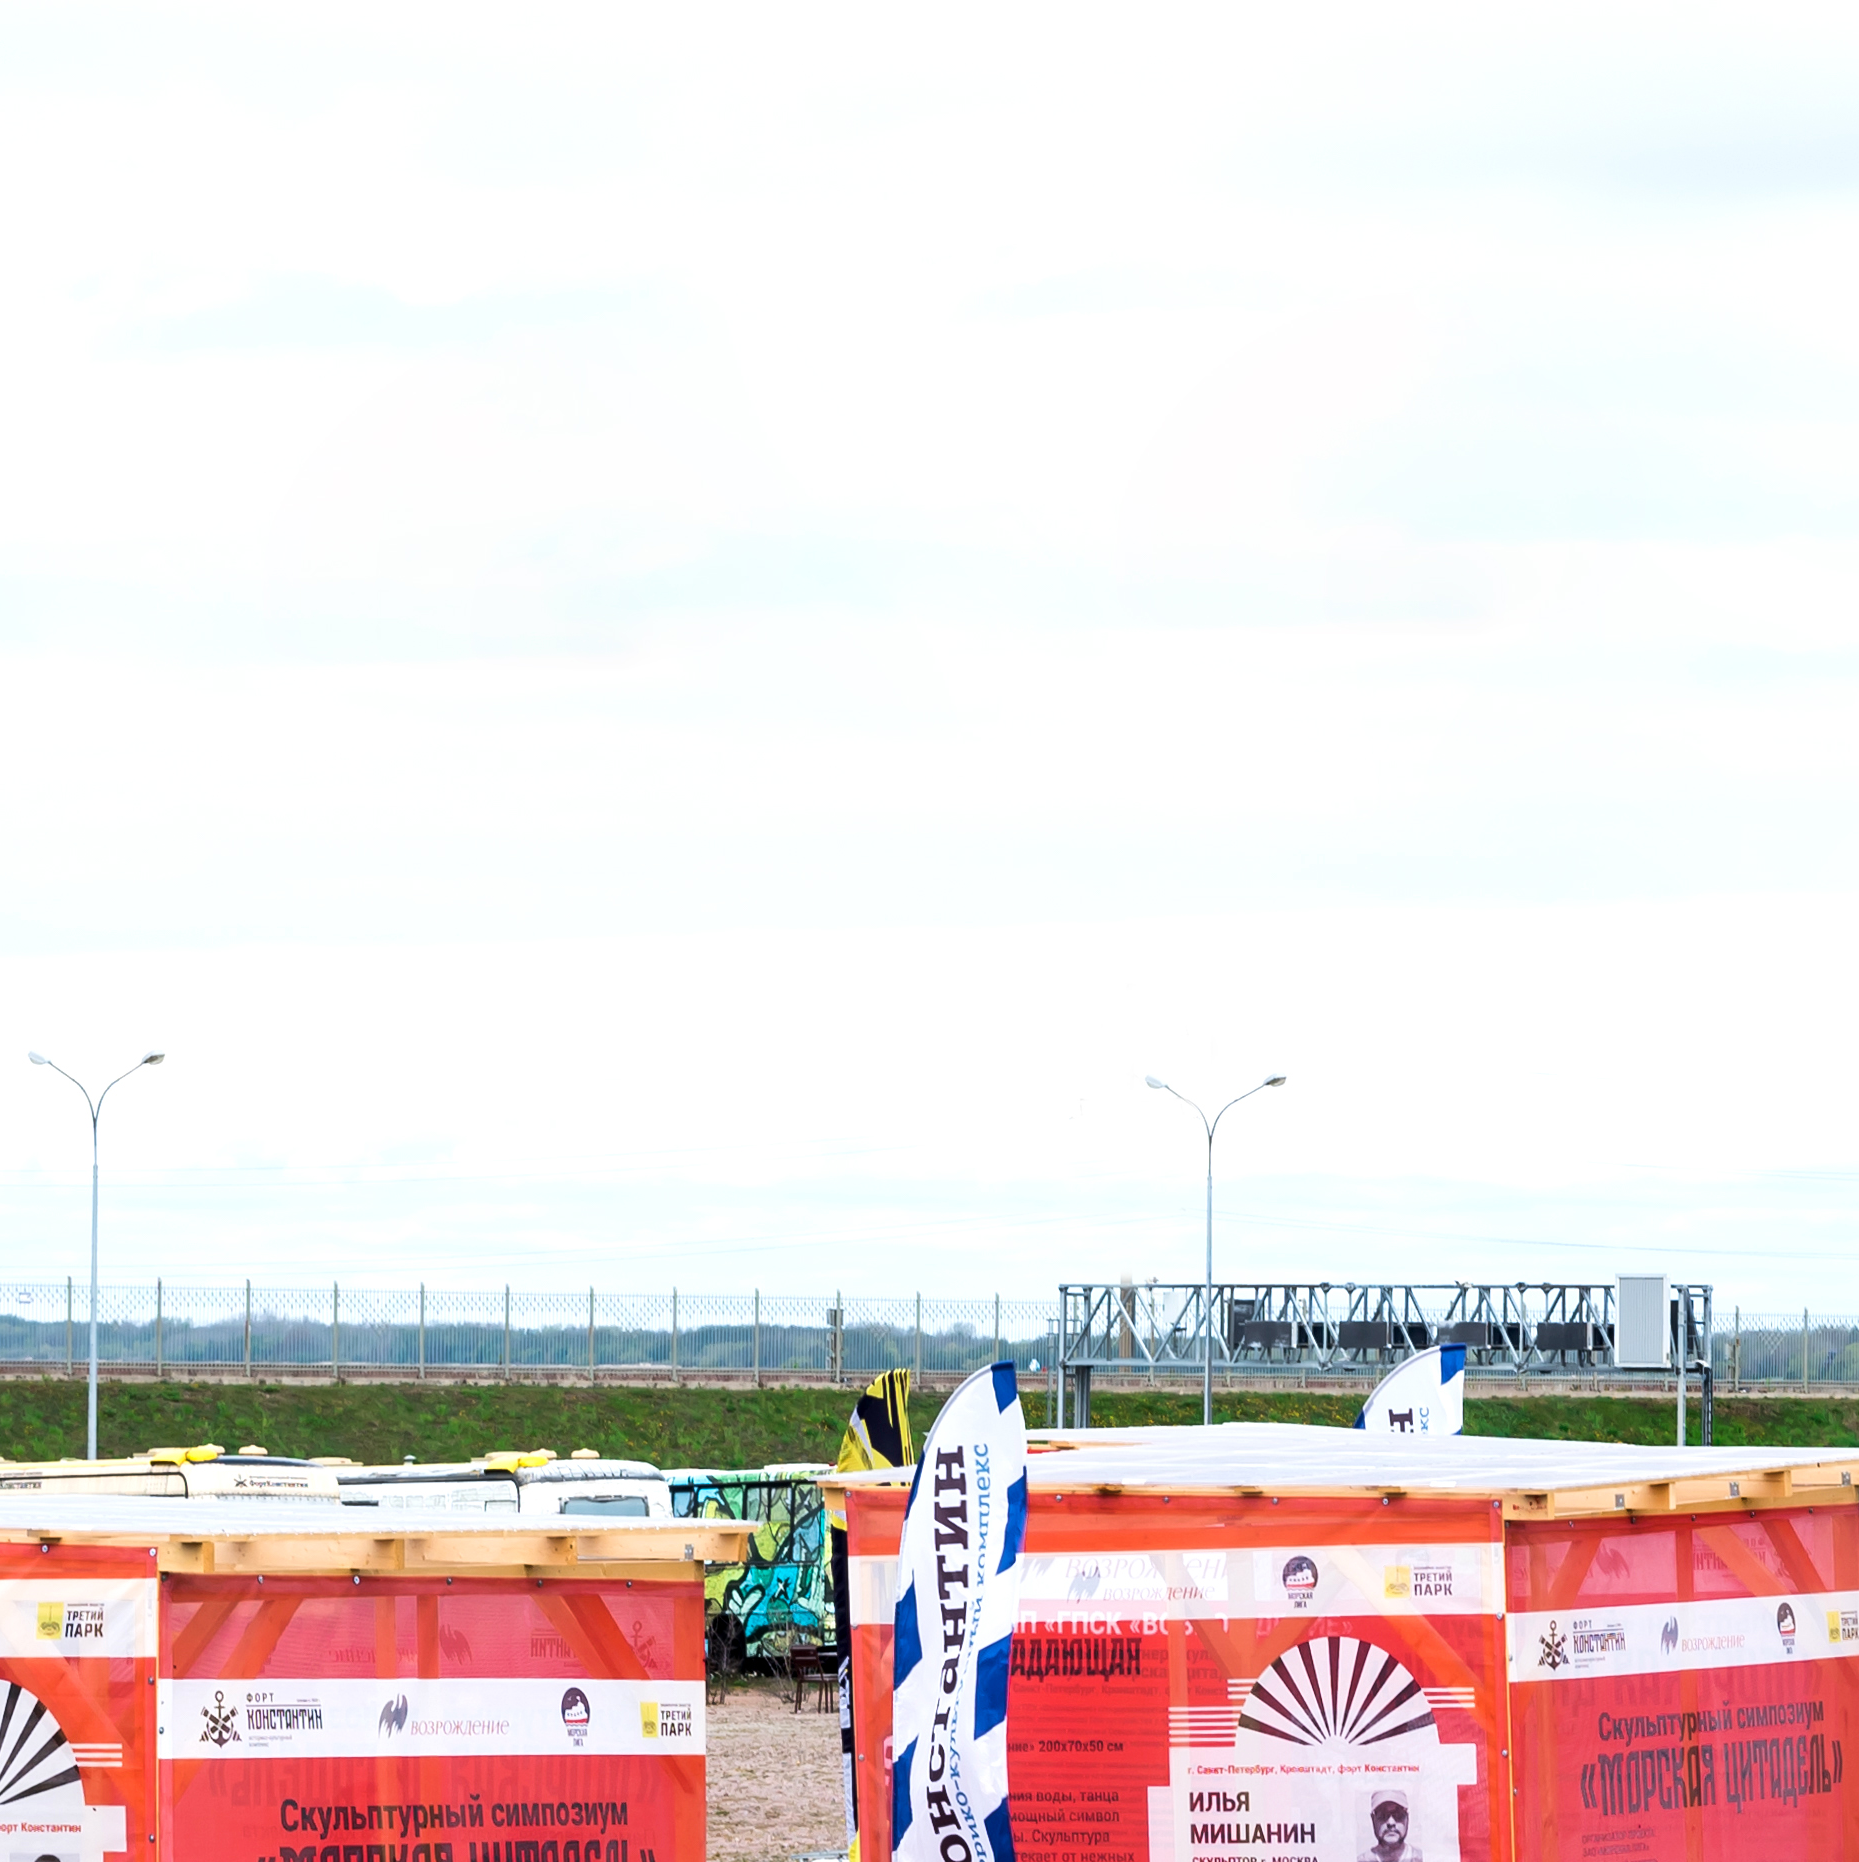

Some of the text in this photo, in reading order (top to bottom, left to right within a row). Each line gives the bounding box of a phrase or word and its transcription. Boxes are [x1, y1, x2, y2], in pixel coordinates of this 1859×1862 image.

[973, 1443, 991, 1590] комплекс
[1414, 1569, 1452, 1582] ТРЕТИЙ
[1414, 1583, 1452, 1596] ПАРК
[67, 1607, 104, 1621] ТРЕТИЙ
[65, 1623, 103, 1638] ПАРК
[1573, 1631, 1626, 1653] КОНСТАНТИН
[247, 1693, 273, 1703] ФОРТ
[246, 1708, 323, 1731] КОНСТАНТИН
[661, 1709, 691, 1721] ТРЕТИЙ
[661, 1722, 692, 1737] ПАРК
[1598, 1700, 1824, 1747] Скульптурный симпозиум
[1197, 1765, 1277, 1776] Санкт-Петербург,
[1580, 1733, 1841, 1817] «МОРСКАЯ ЦИТАДЕЛЬ»
[1190, 1792, 1250, 1812] ИЛЬЯ
[281, 1794, 628, 1839] Скульптурный симпозиум
[1069, 1811, 1119, 1822] символ
[21, 1822, 81, 1833] Константин
[1190, 1823, 1315, 1844] МИШАНИН
[1032, 1830, 1110, 1845] Скульптура
[1081, 1852, 1134, 1862] нежных
